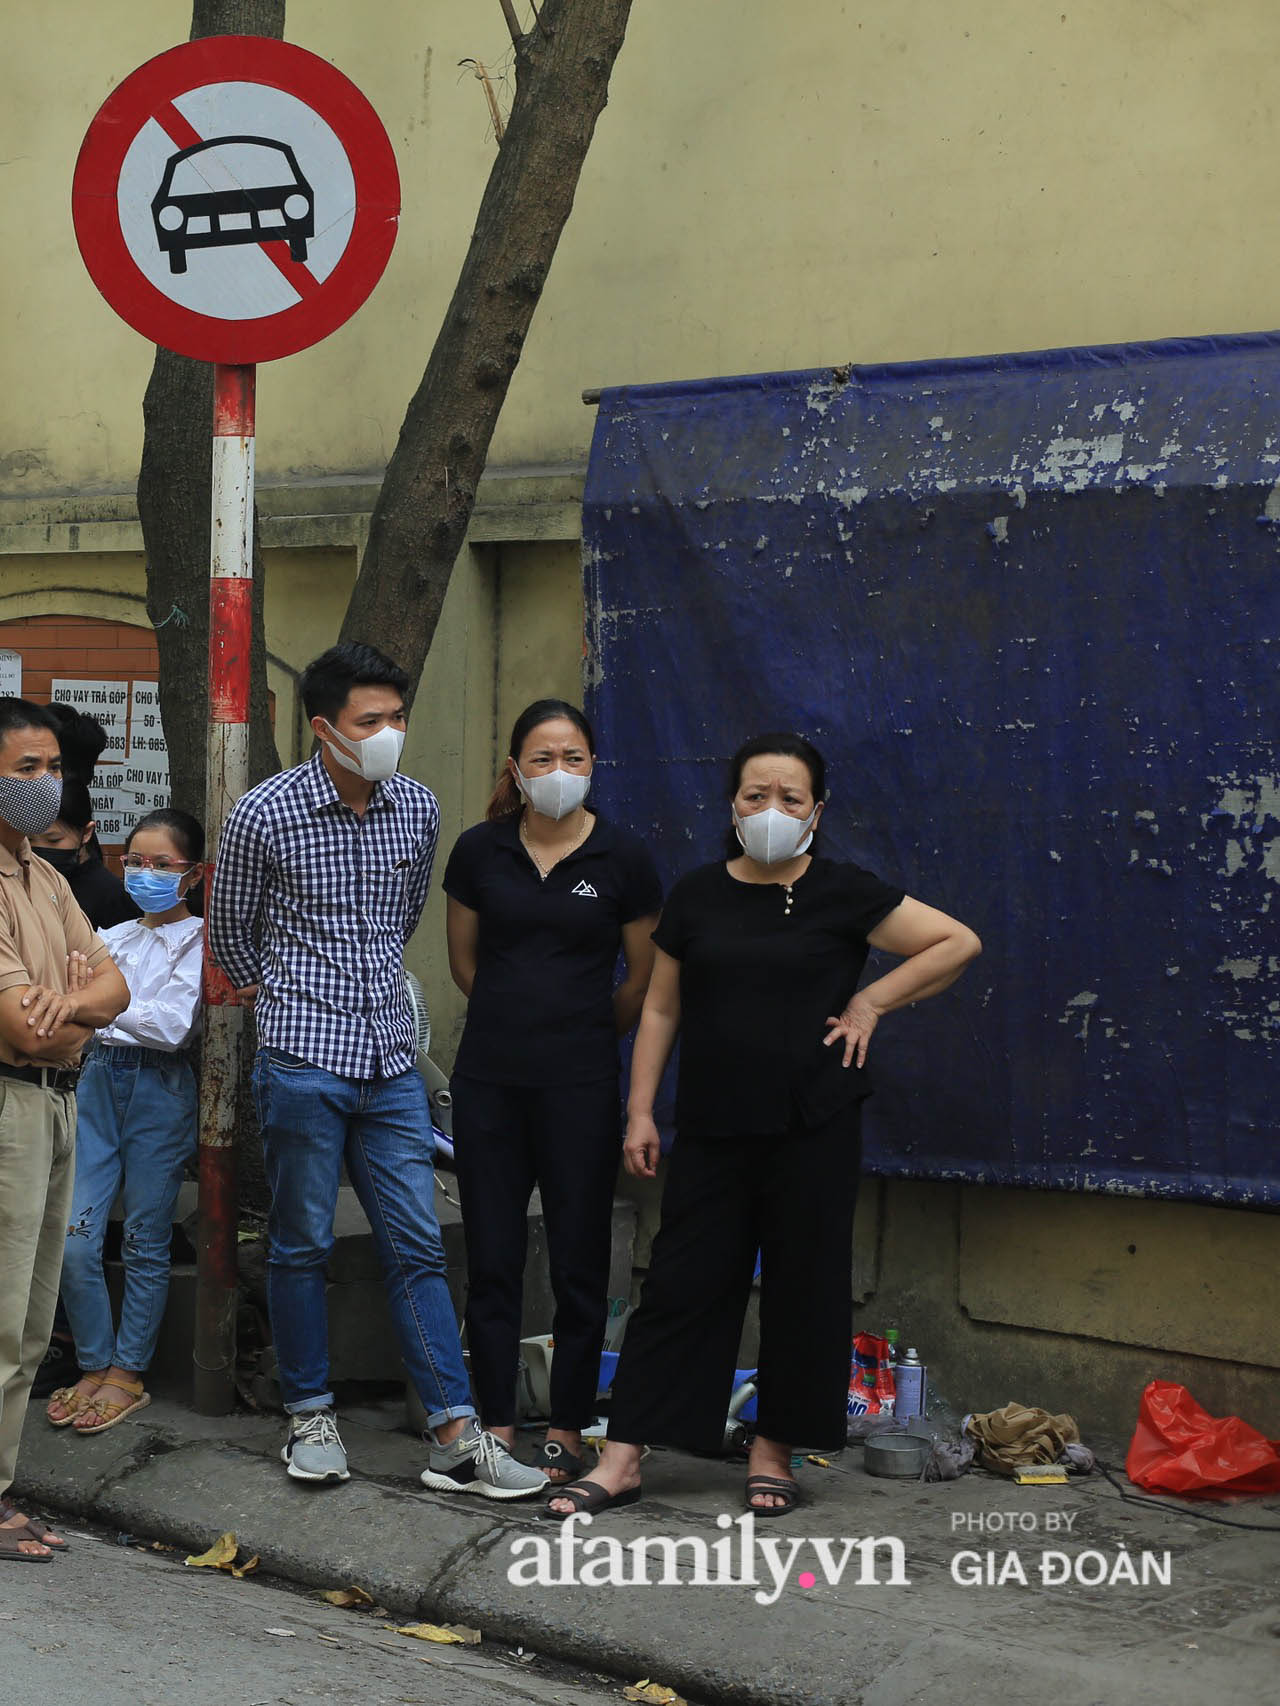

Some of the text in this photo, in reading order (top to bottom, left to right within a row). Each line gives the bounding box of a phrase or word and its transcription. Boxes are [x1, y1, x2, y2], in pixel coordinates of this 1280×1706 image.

[54, 685, 126, 705] CHO VAY TRẢ GÓP
[135, 691, 153, 705] CHO
[144, 715, 155, 728] 50
[132, 736, 147, 750] LH:
[126, 768, 144, 783] CHO
[146, 771, 163, 785] VAY
[91, 795, 114, 810] NGÀY
[134, 792, 146, 806] 50
[153, 794, 165, 808] 60
[123, 812, 138, 828] LH:
